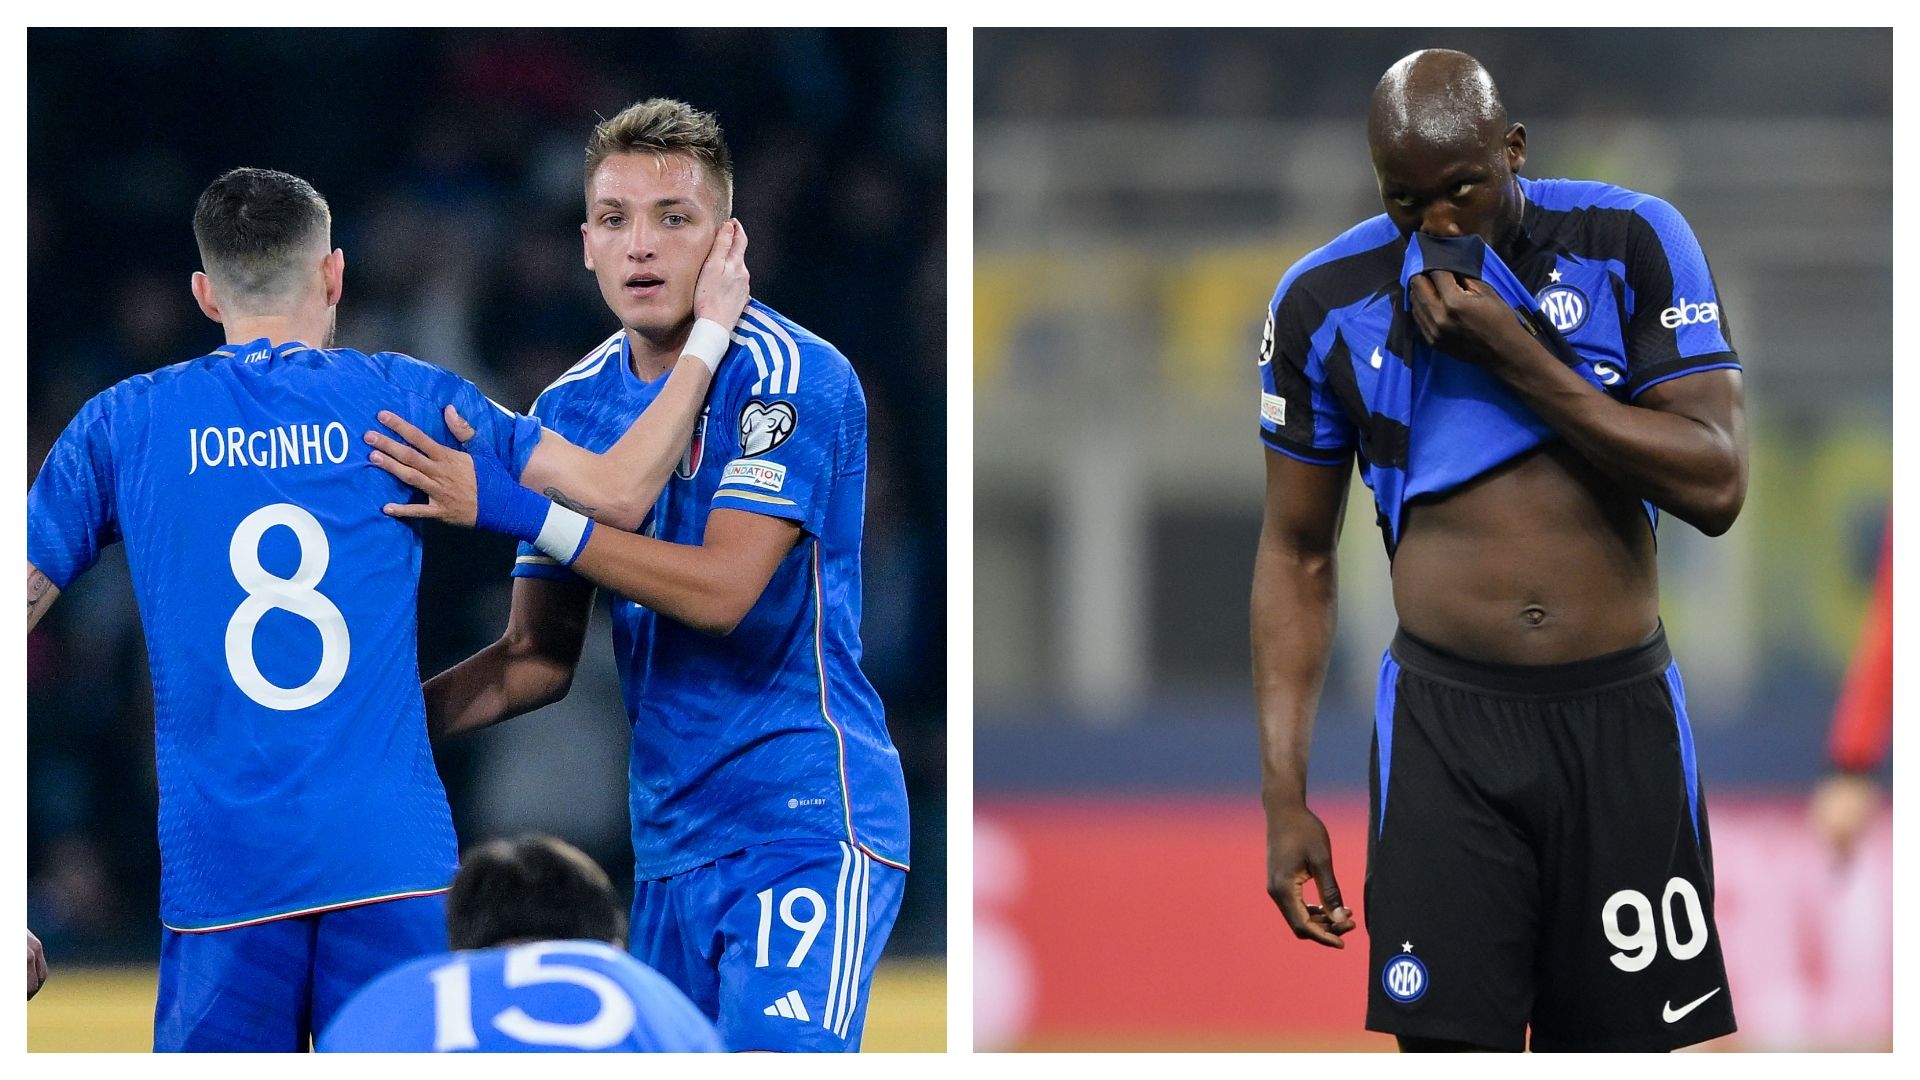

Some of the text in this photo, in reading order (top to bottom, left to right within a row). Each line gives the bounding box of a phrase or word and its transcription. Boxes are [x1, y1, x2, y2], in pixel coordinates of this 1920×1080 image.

[244, 349, 272, 364] ITAL
[189, 421, 349, 475] JORGINHO
[224, 503, 351, 711] 8
[755, 887, 827, 969] 19
[1601, 876, 1709, 973] 90
[429, 940, 638, 1052] 15
